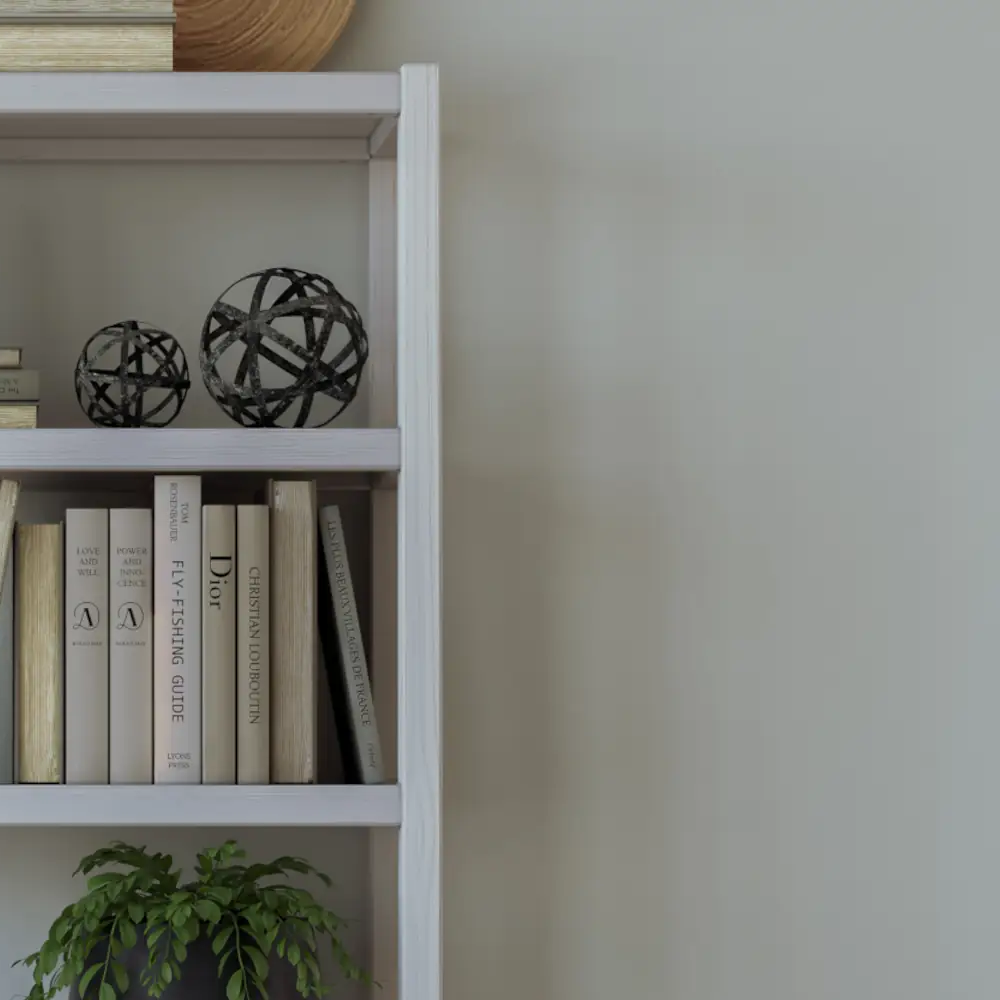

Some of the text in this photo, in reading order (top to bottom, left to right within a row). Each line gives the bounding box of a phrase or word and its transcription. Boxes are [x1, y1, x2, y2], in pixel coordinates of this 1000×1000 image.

[180, 502, 190, 524] TOM
[76, 547, 100, 555] LOVE
[79, 558, 98, 566] AND
[116, 547, 147, 555] POWER
[122, 558, 142, 566] AND
[209, 554, 232, 611] Dior
[335, 571, 351, 609] BEAUX
[171, 559, 185, 723] FLY-FISHING GUIDE
[248, 566, 261, 724] CHRISTIAN LOUBOUTIN
[342, 610, 361, 664] VILLAGES
[351, 666, 363, 680] DE
[355, 682, 371, 727] FRANCE
